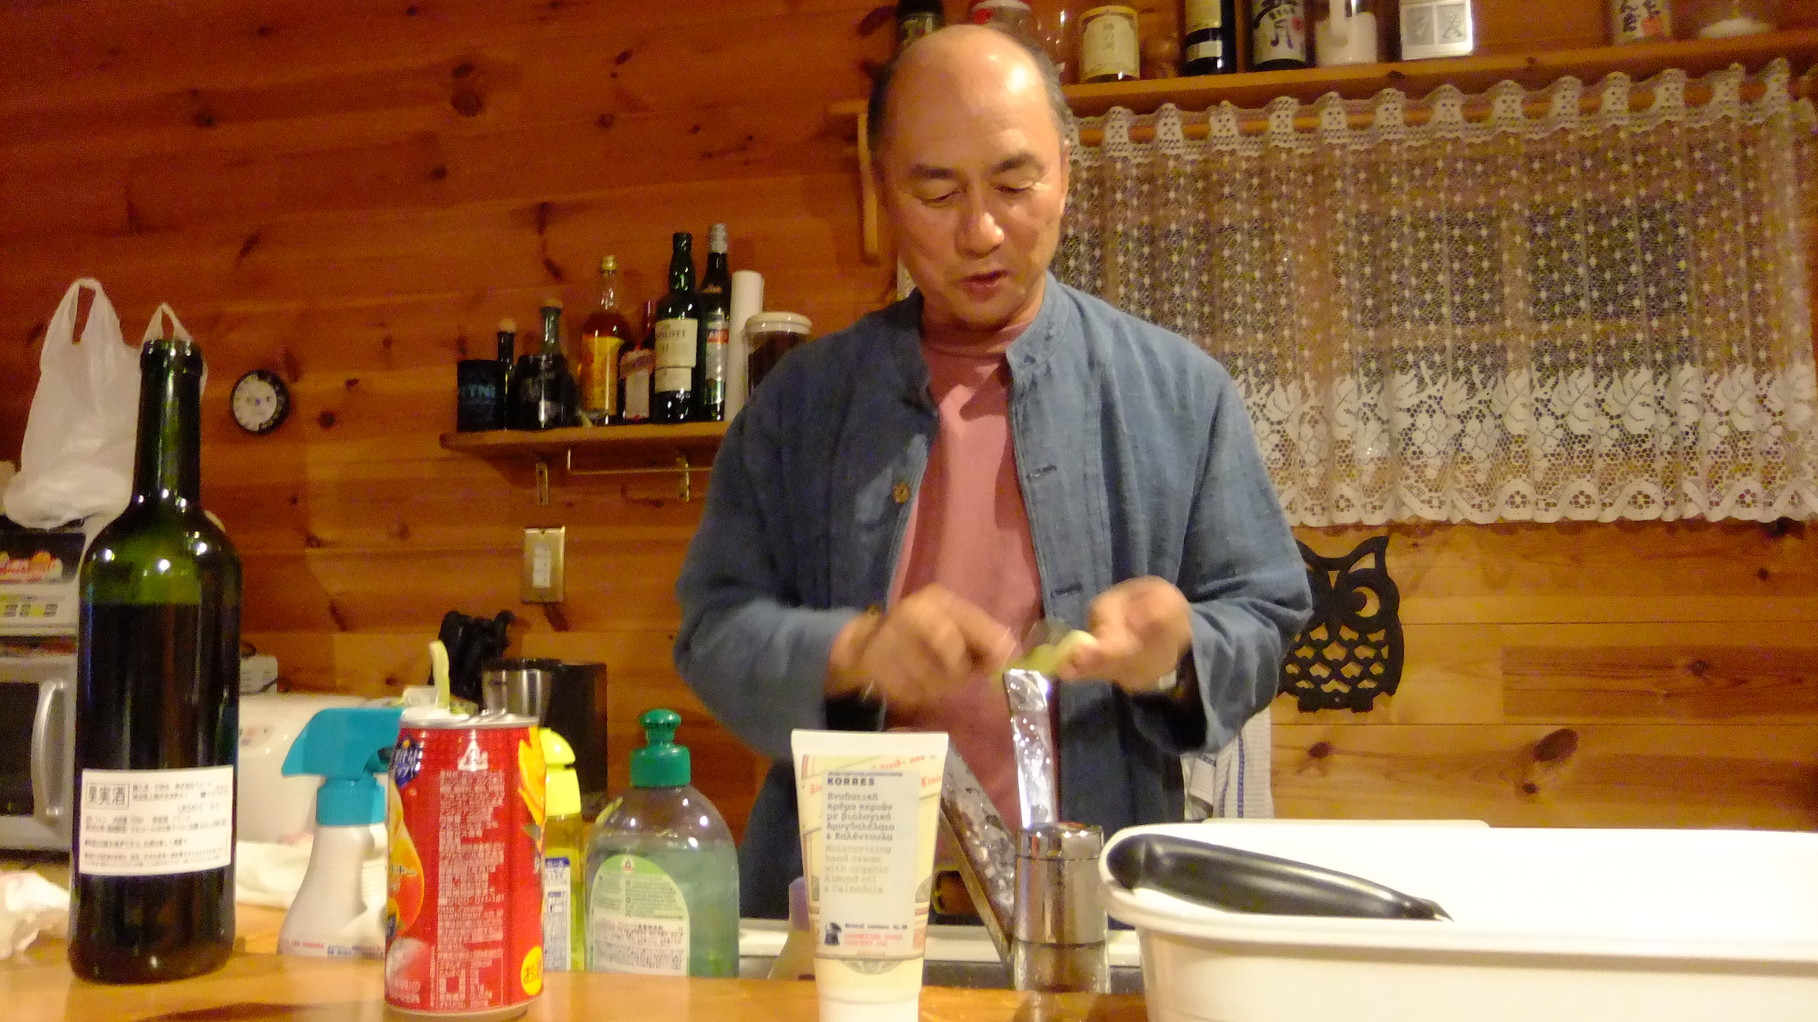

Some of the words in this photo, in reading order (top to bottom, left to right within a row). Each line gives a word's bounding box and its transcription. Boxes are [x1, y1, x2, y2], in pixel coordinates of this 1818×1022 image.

[827, 778, 875, 786] KORRES
[88, 785, 127, 806] 果実酒
[827, 801, 856, 812] κρέμα
[826, 813, 838, 822] με
